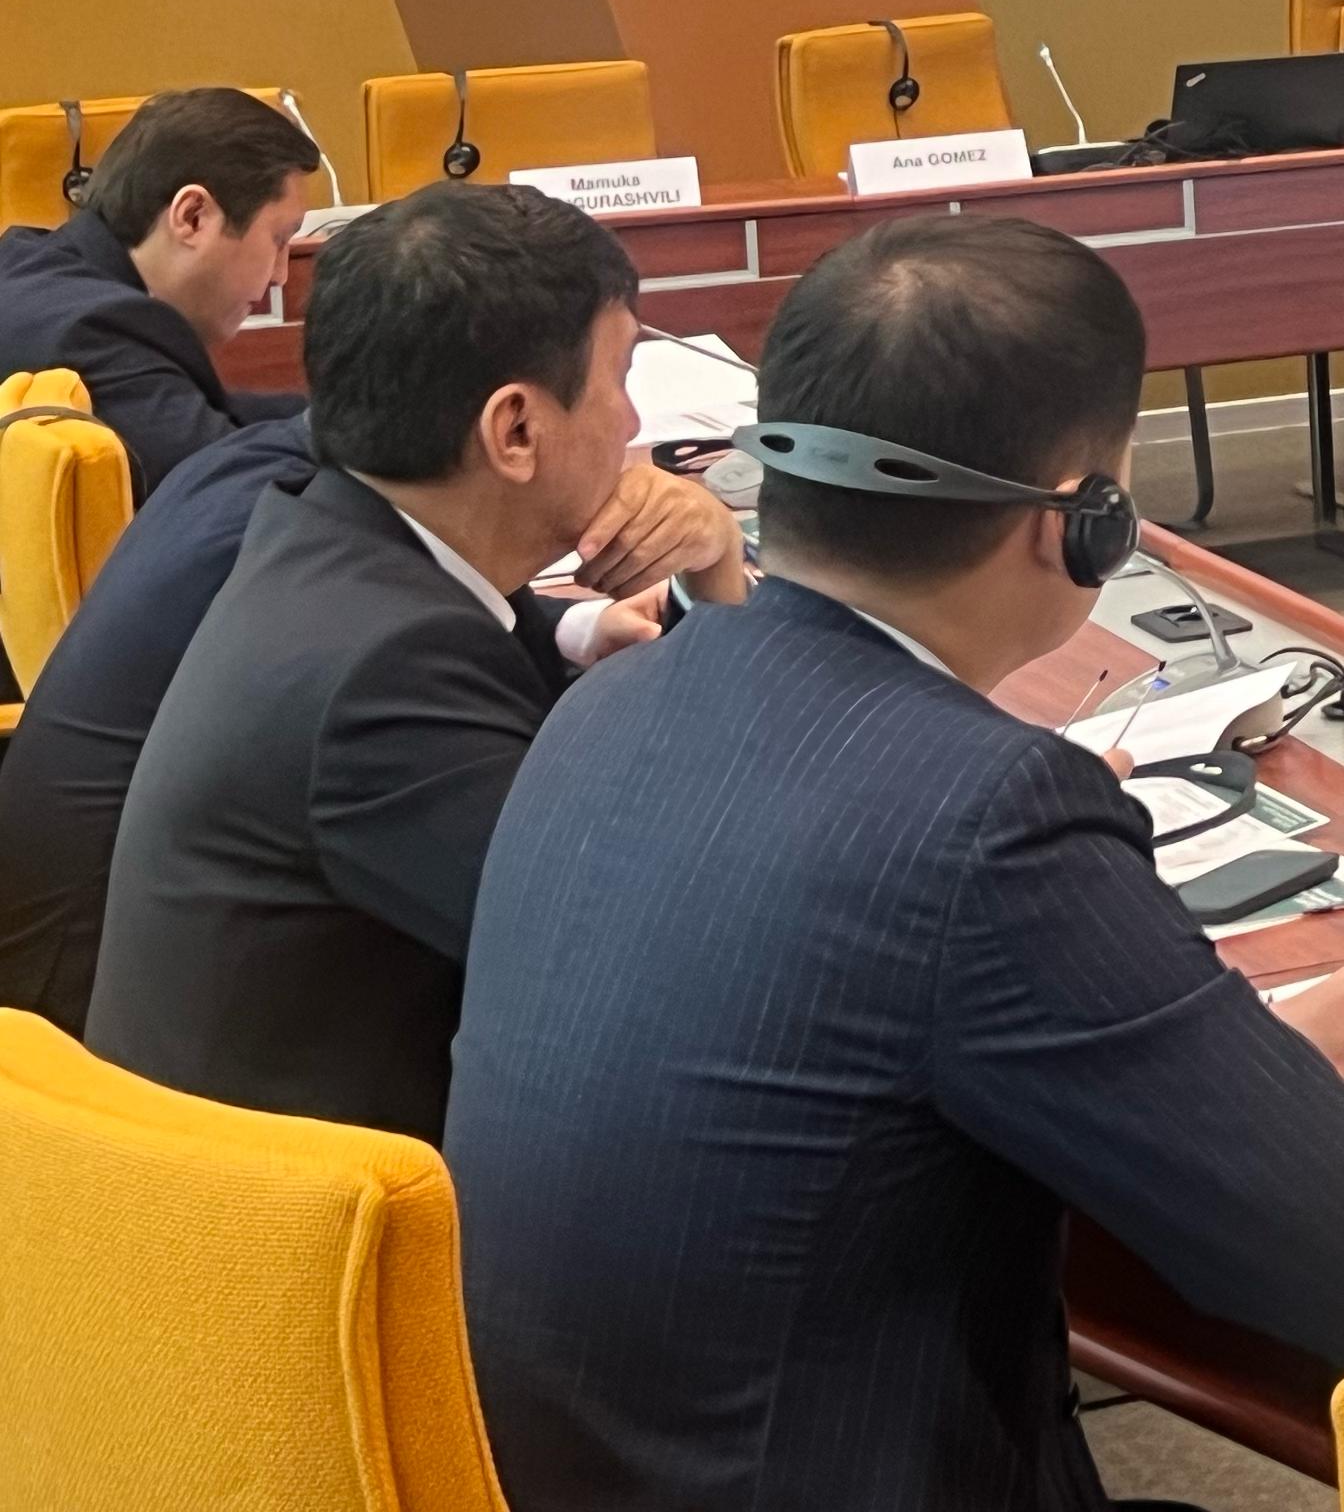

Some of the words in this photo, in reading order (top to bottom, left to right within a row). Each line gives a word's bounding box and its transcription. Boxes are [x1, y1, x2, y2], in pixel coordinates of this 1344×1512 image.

[892, 155, 923, 169] Ana
[927, 148, 986, 166] GOMEZ
[569, 174, 641, 191] Mamuka
[565, 190, 681, 210] GURASHVILI
